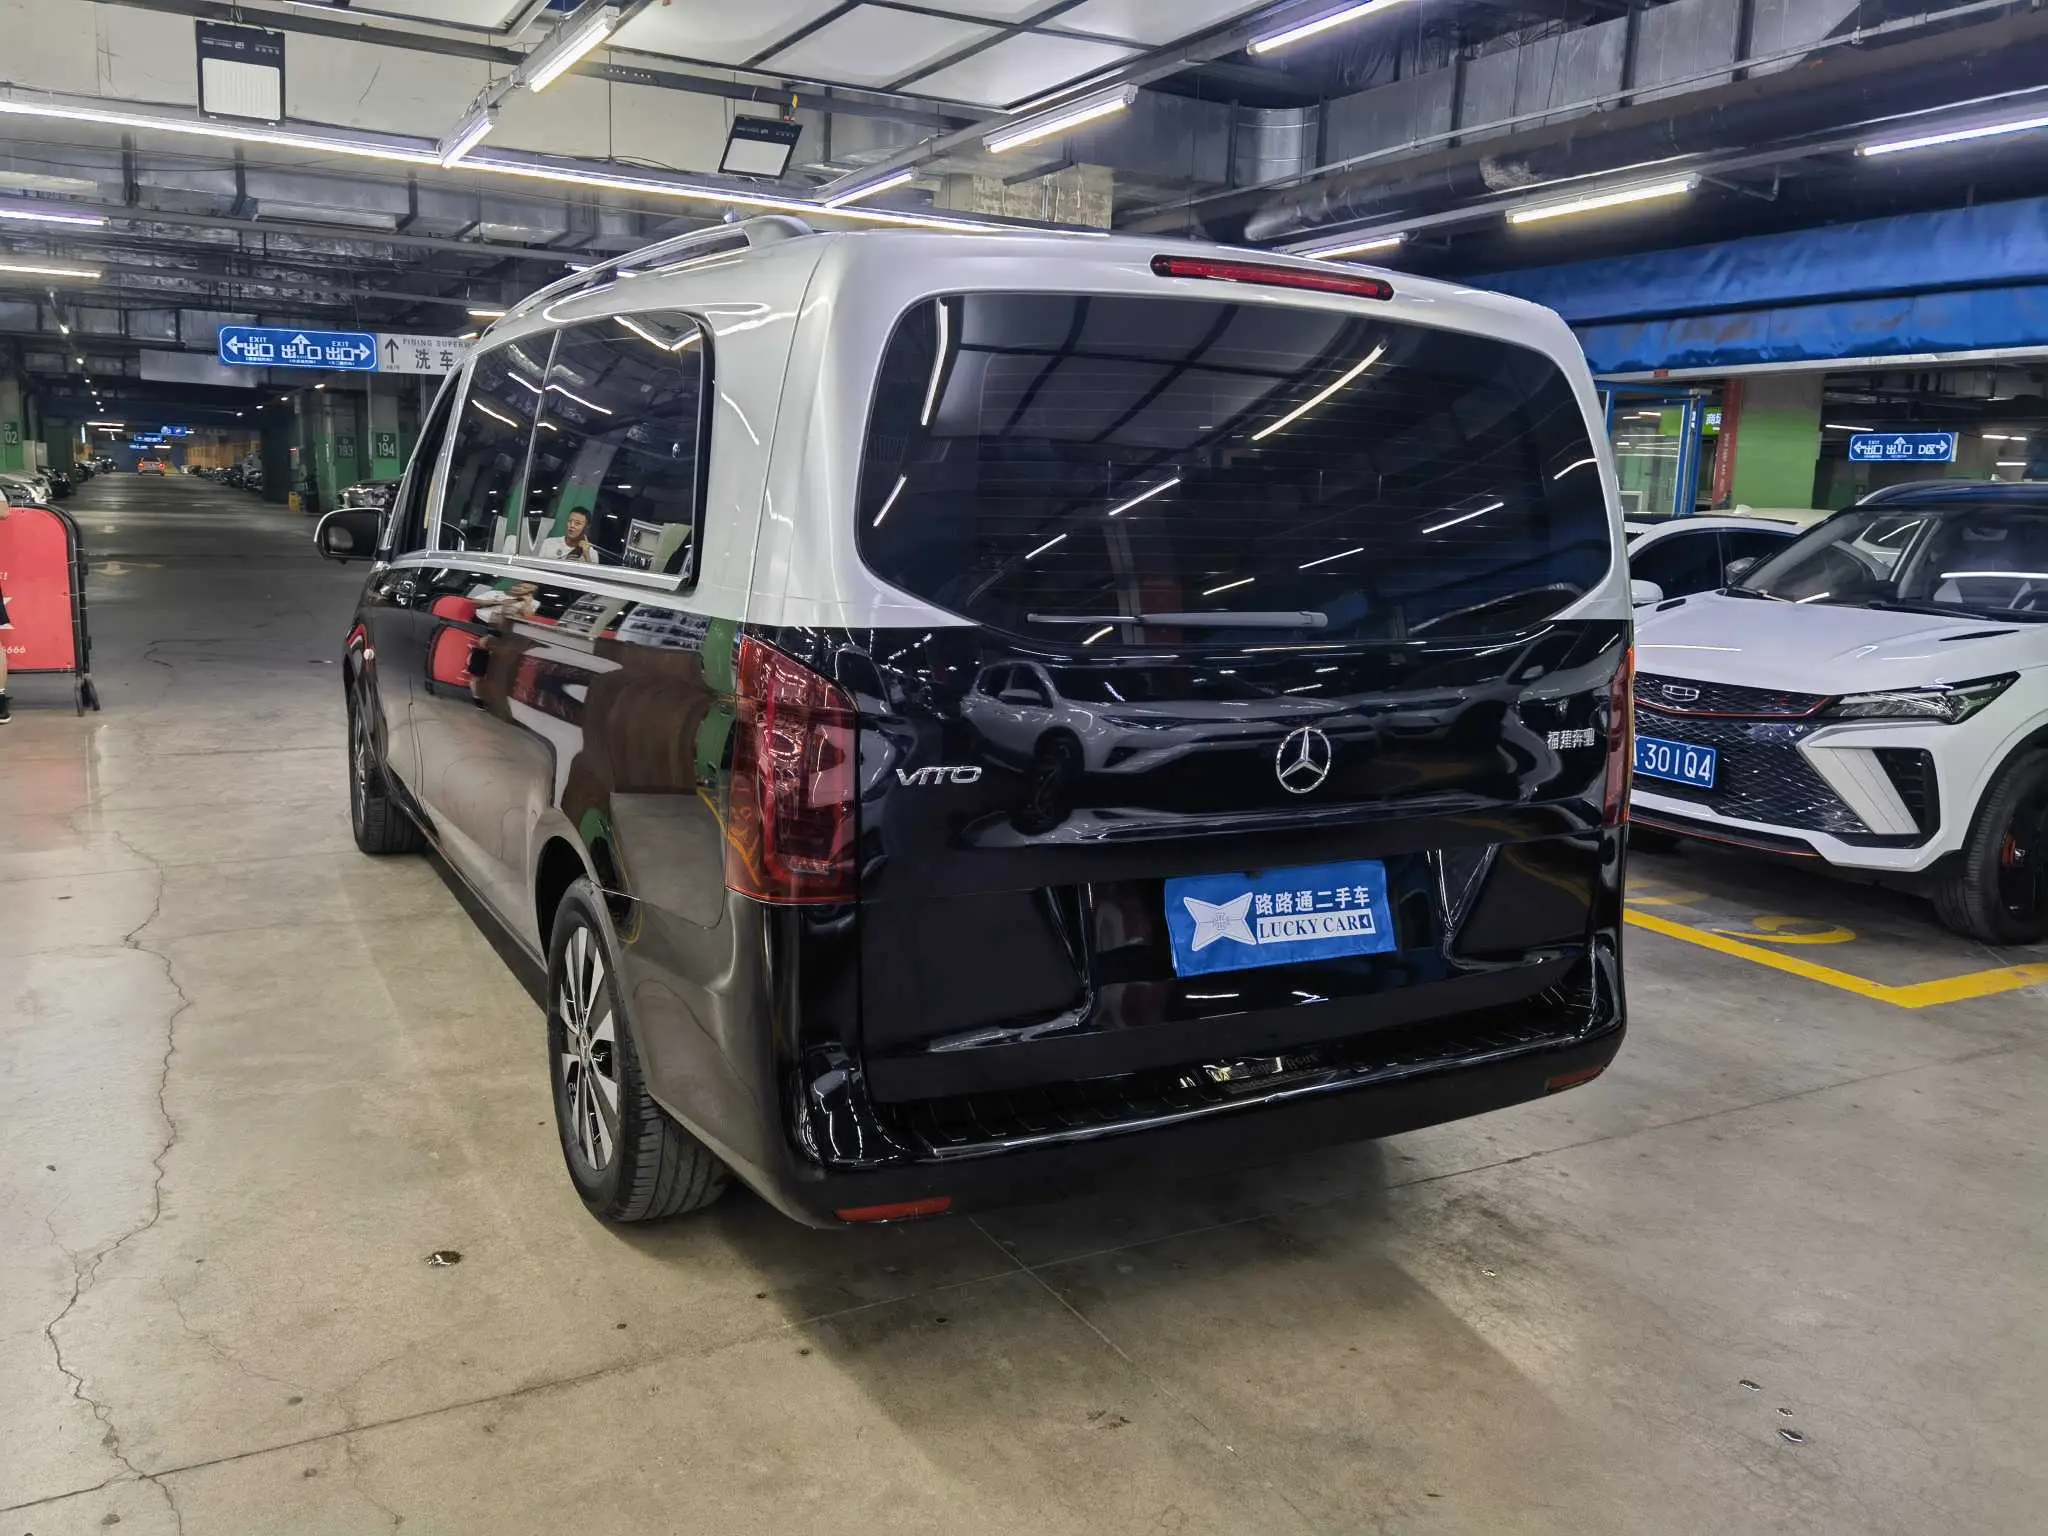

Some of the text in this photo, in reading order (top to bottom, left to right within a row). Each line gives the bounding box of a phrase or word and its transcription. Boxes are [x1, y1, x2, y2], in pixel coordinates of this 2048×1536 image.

[244, 343, 274, 358] 出口
[281, 344, 322, 360] 出口
[325, 346, 355, 361] 出口
[377, 442, 395, 457] 194
[1864, 444, 1936, 455] 出口 出口 D区
[896, 766, 982, 786] VITO
[1255, 886, 1370, 915] 路路通二手车
[1259, 914, 1360, 938] LUCKY CAR
